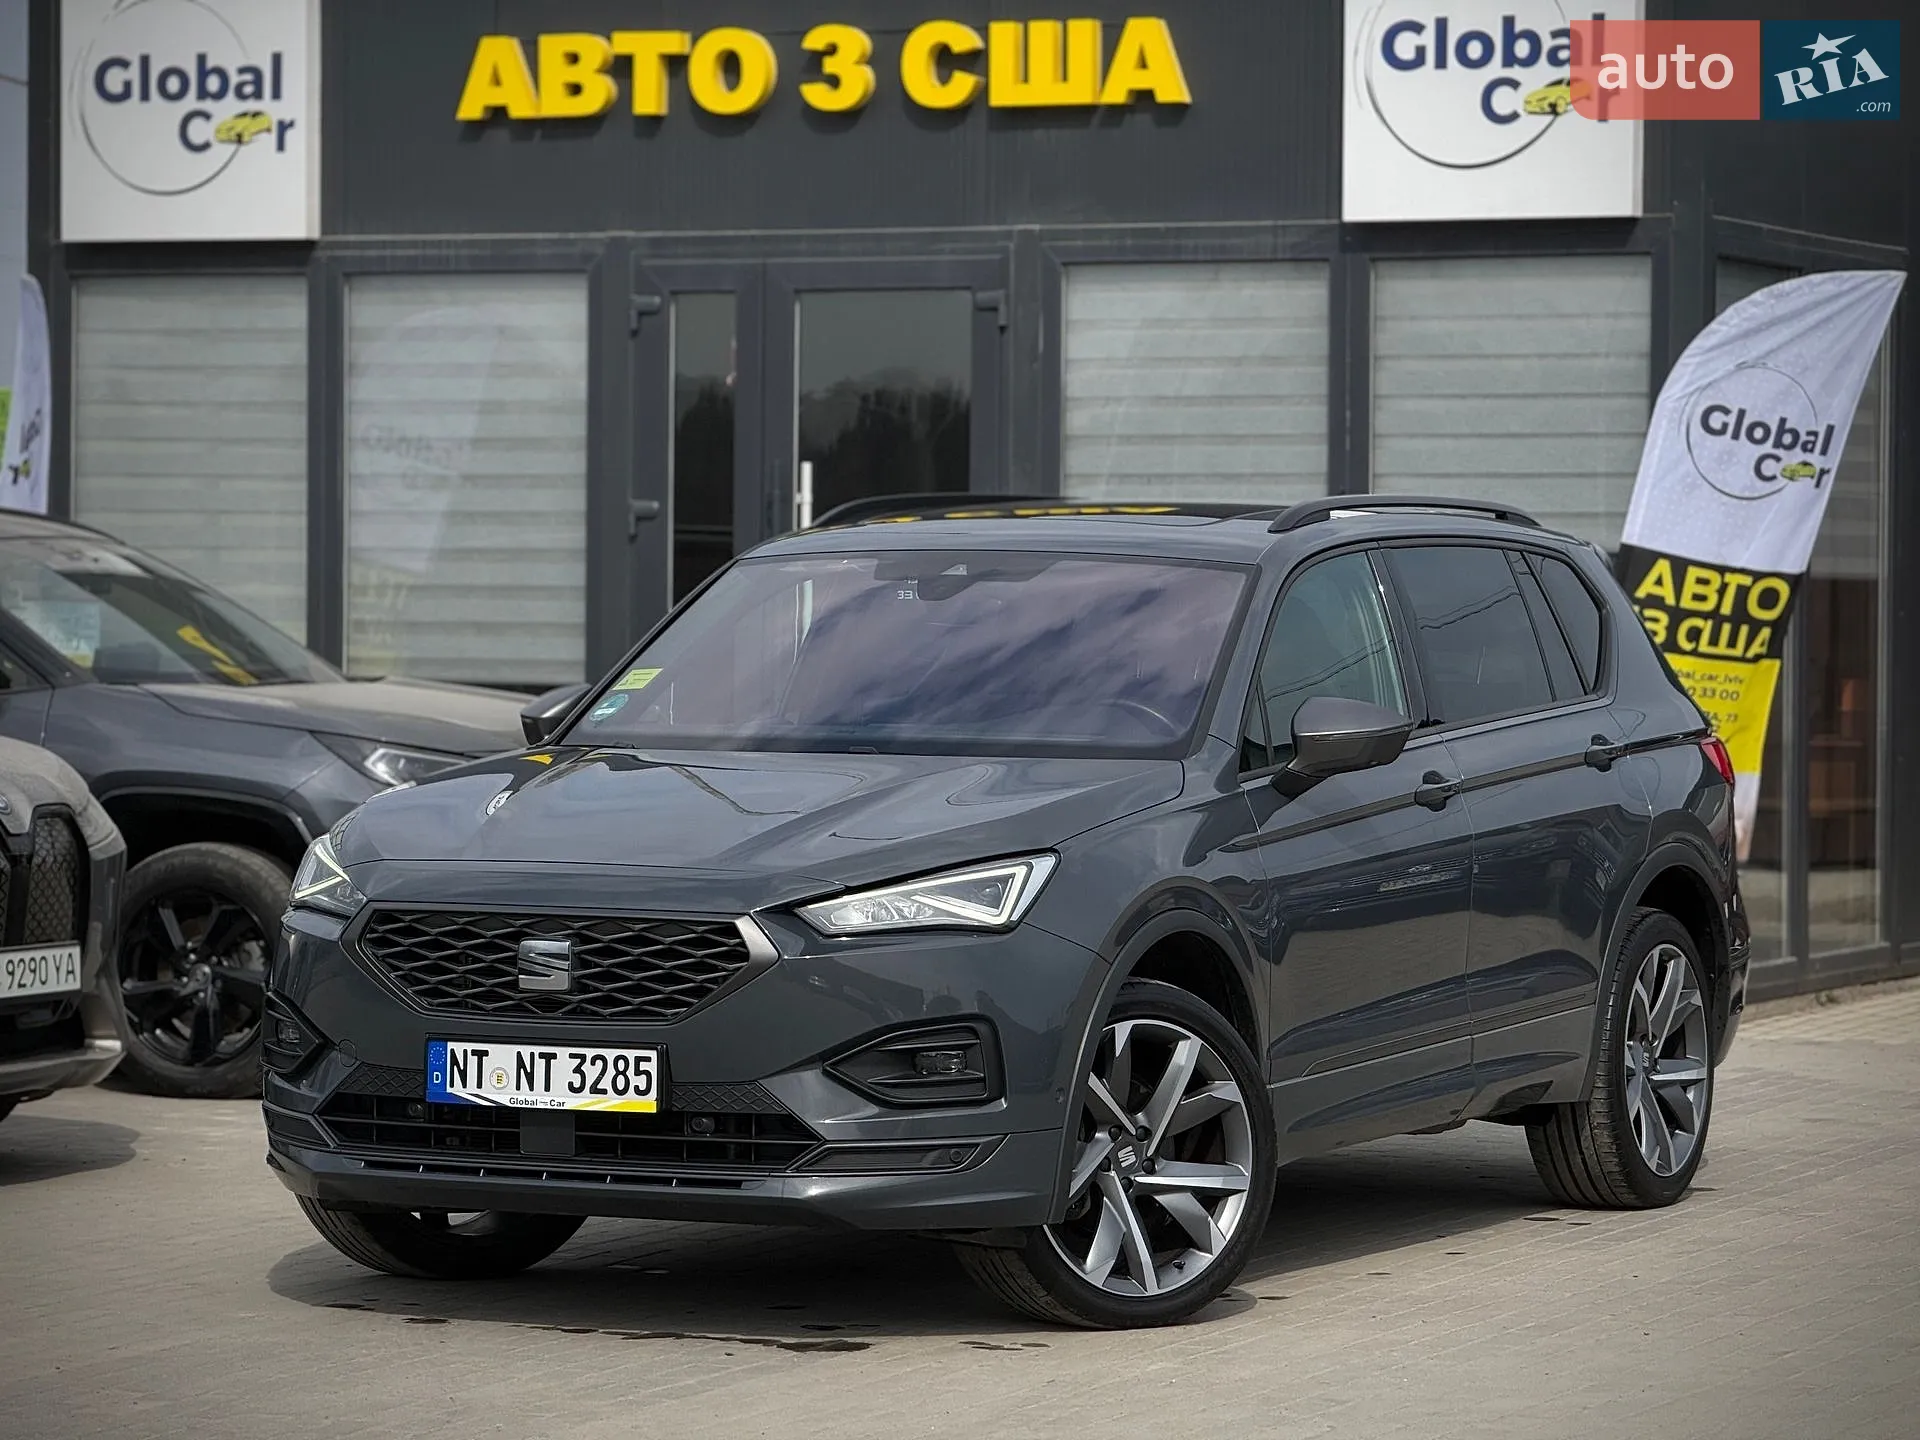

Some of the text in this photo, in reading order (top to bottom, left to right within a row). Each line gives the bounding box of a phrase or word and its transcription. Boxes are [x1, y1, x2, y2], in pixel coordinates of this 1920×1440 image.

[1380, 13, 1607, 72] Global
[94, 52, 283, 103] Global
[455, 26, 779, 121] АВТО
[900, 16, 1193, 109] США
[178, 109, 295, 153] Cr
[1700, 404, 1835, 457] Global
[1754, 453, 1831, 488] Cr
[1634, 557, 1791, 622] АВТО
[1676, 616, 1773, 659] США
[5, 955, 49, 991] 9290
[433, 1071, 442, 1084] D
[449, 1047, 653, 1097] NT NT 3285
[509, 1097, 538, 1107] Global
[549, 1099, 567, 1108] Car
